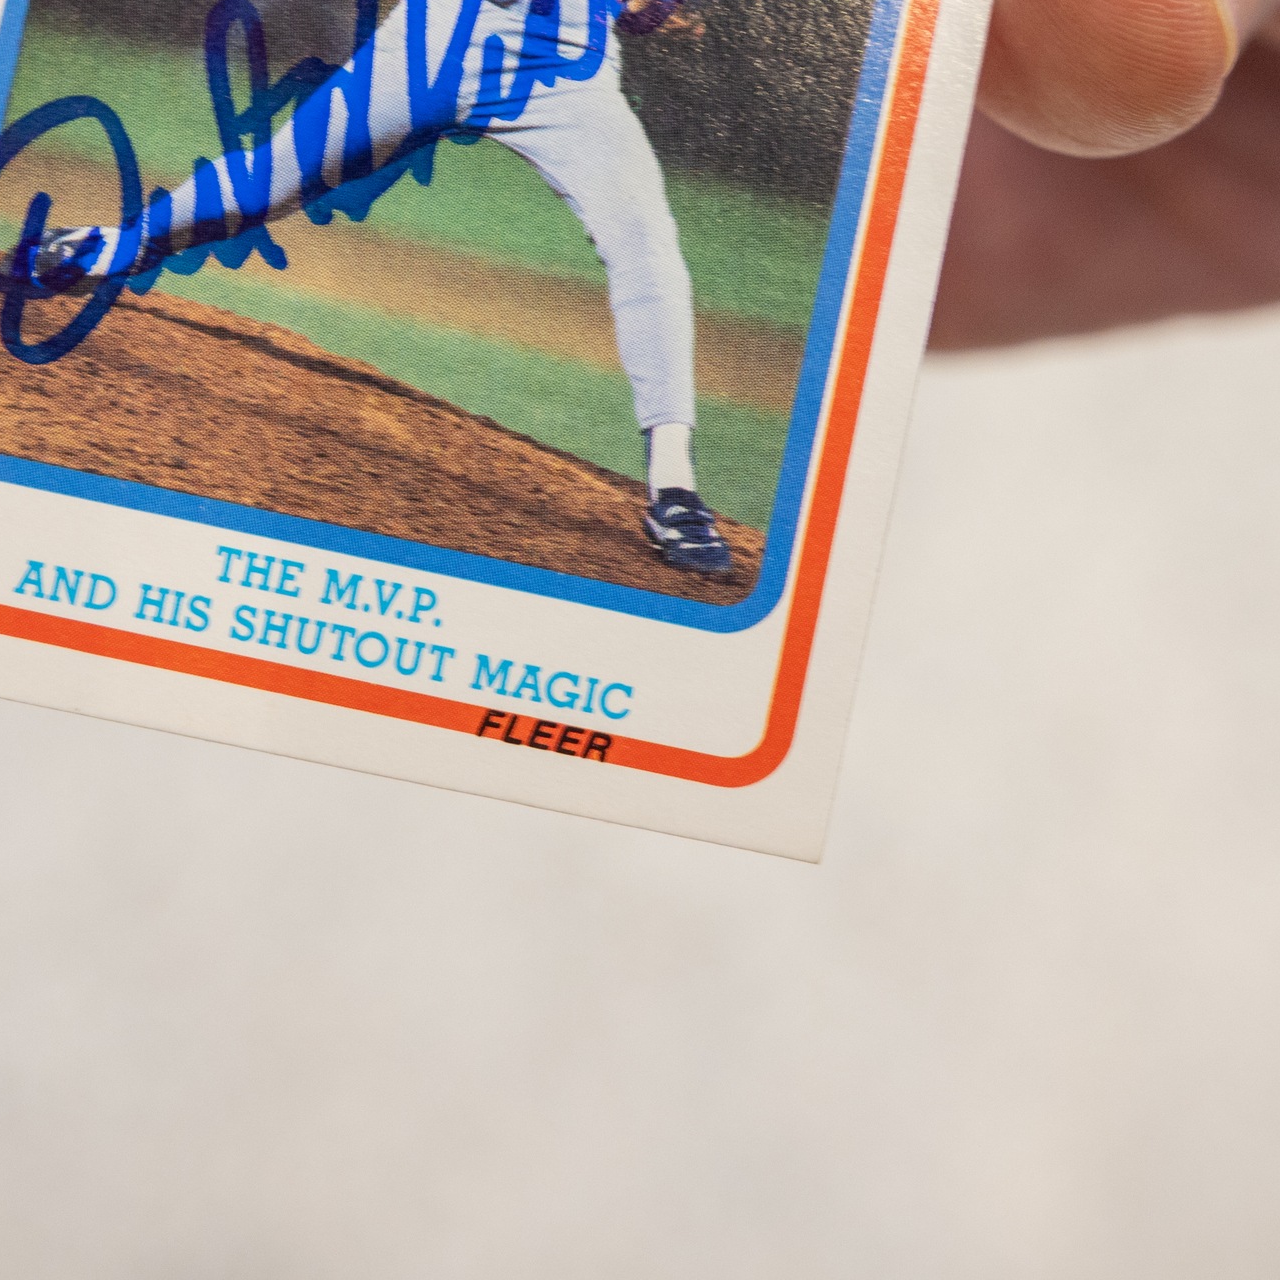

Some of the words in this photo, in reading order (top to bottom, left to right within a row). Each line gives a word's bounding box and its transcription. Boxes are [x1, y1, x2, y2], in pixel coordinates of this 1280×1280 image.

[216, 546, 305, 598] THE
[320, 568, 443, 628] M.V.P.
[14, 561, 117, 611] AND
[135, 584, 212, 632] HIS
[230, 606, 457, 683] SHUTOUT
[471, 653, 634, 721] MAGIC
[476, 709, 613, 763] FLEER
